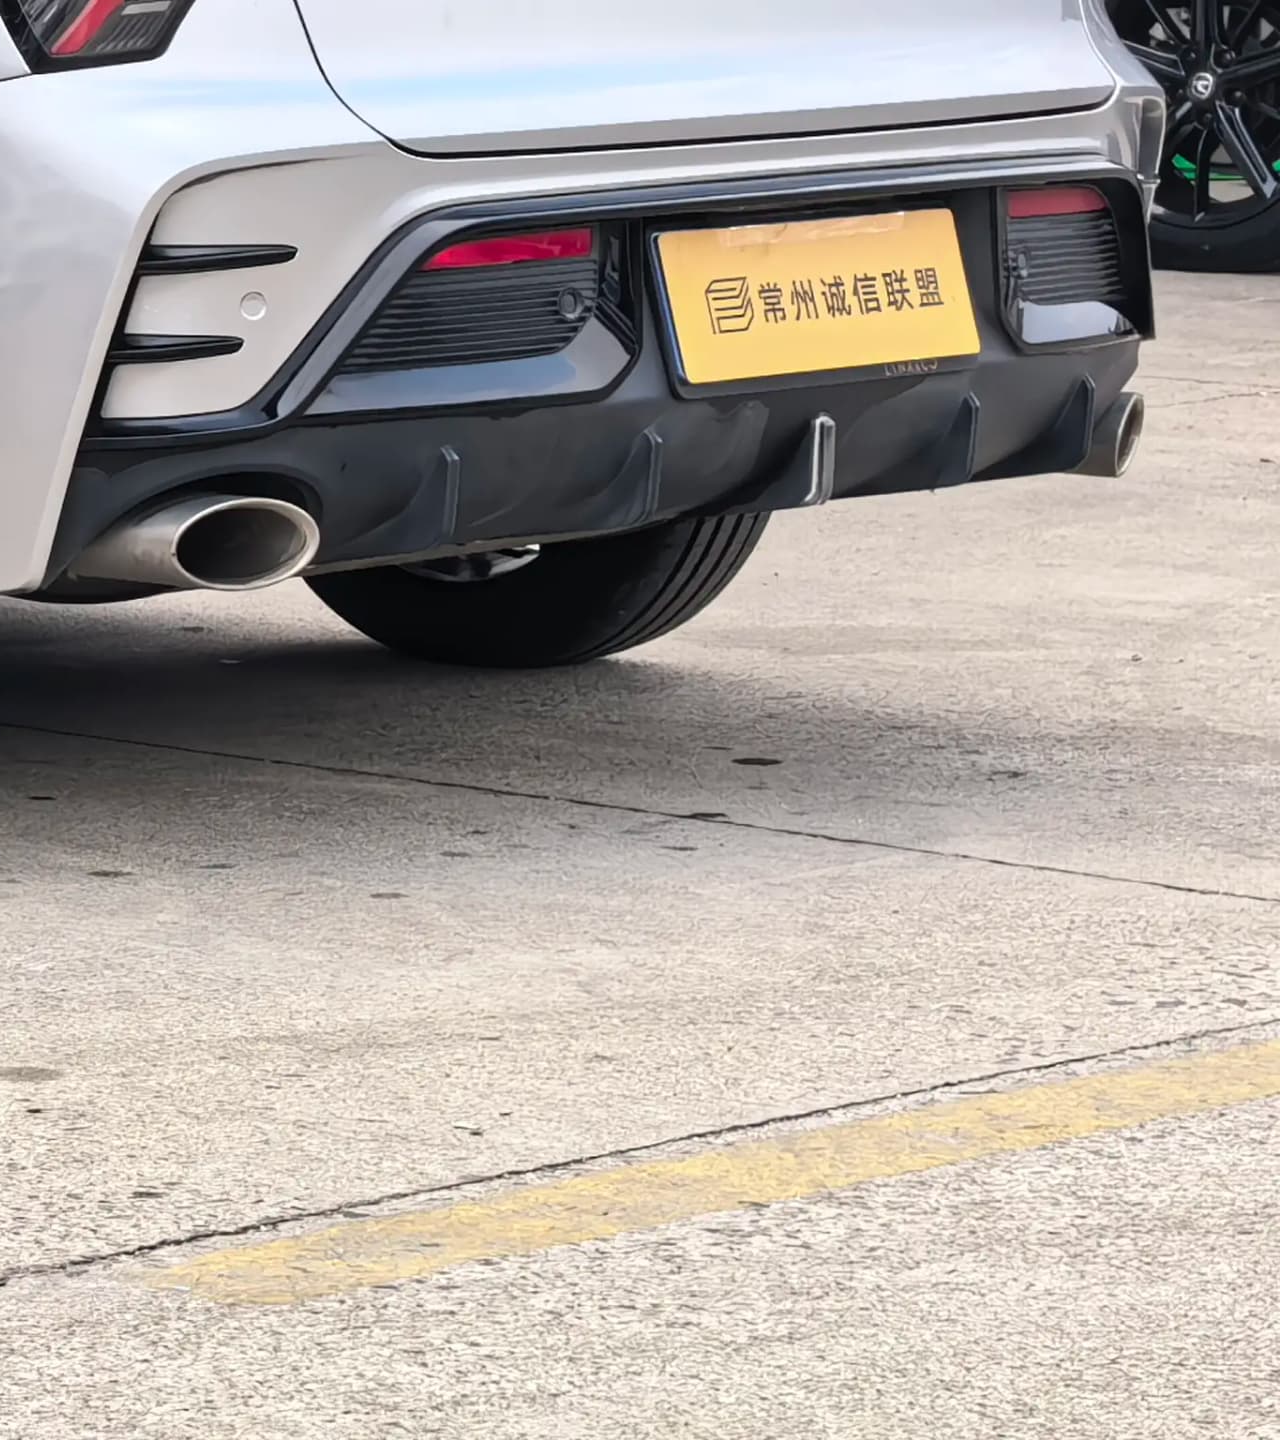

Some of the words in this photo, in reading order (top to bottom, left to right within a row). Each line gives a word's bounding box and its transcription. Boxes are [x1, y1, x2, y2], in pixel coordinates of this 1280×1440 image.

[757, 266, 945, 324] 常州诚信联盟
